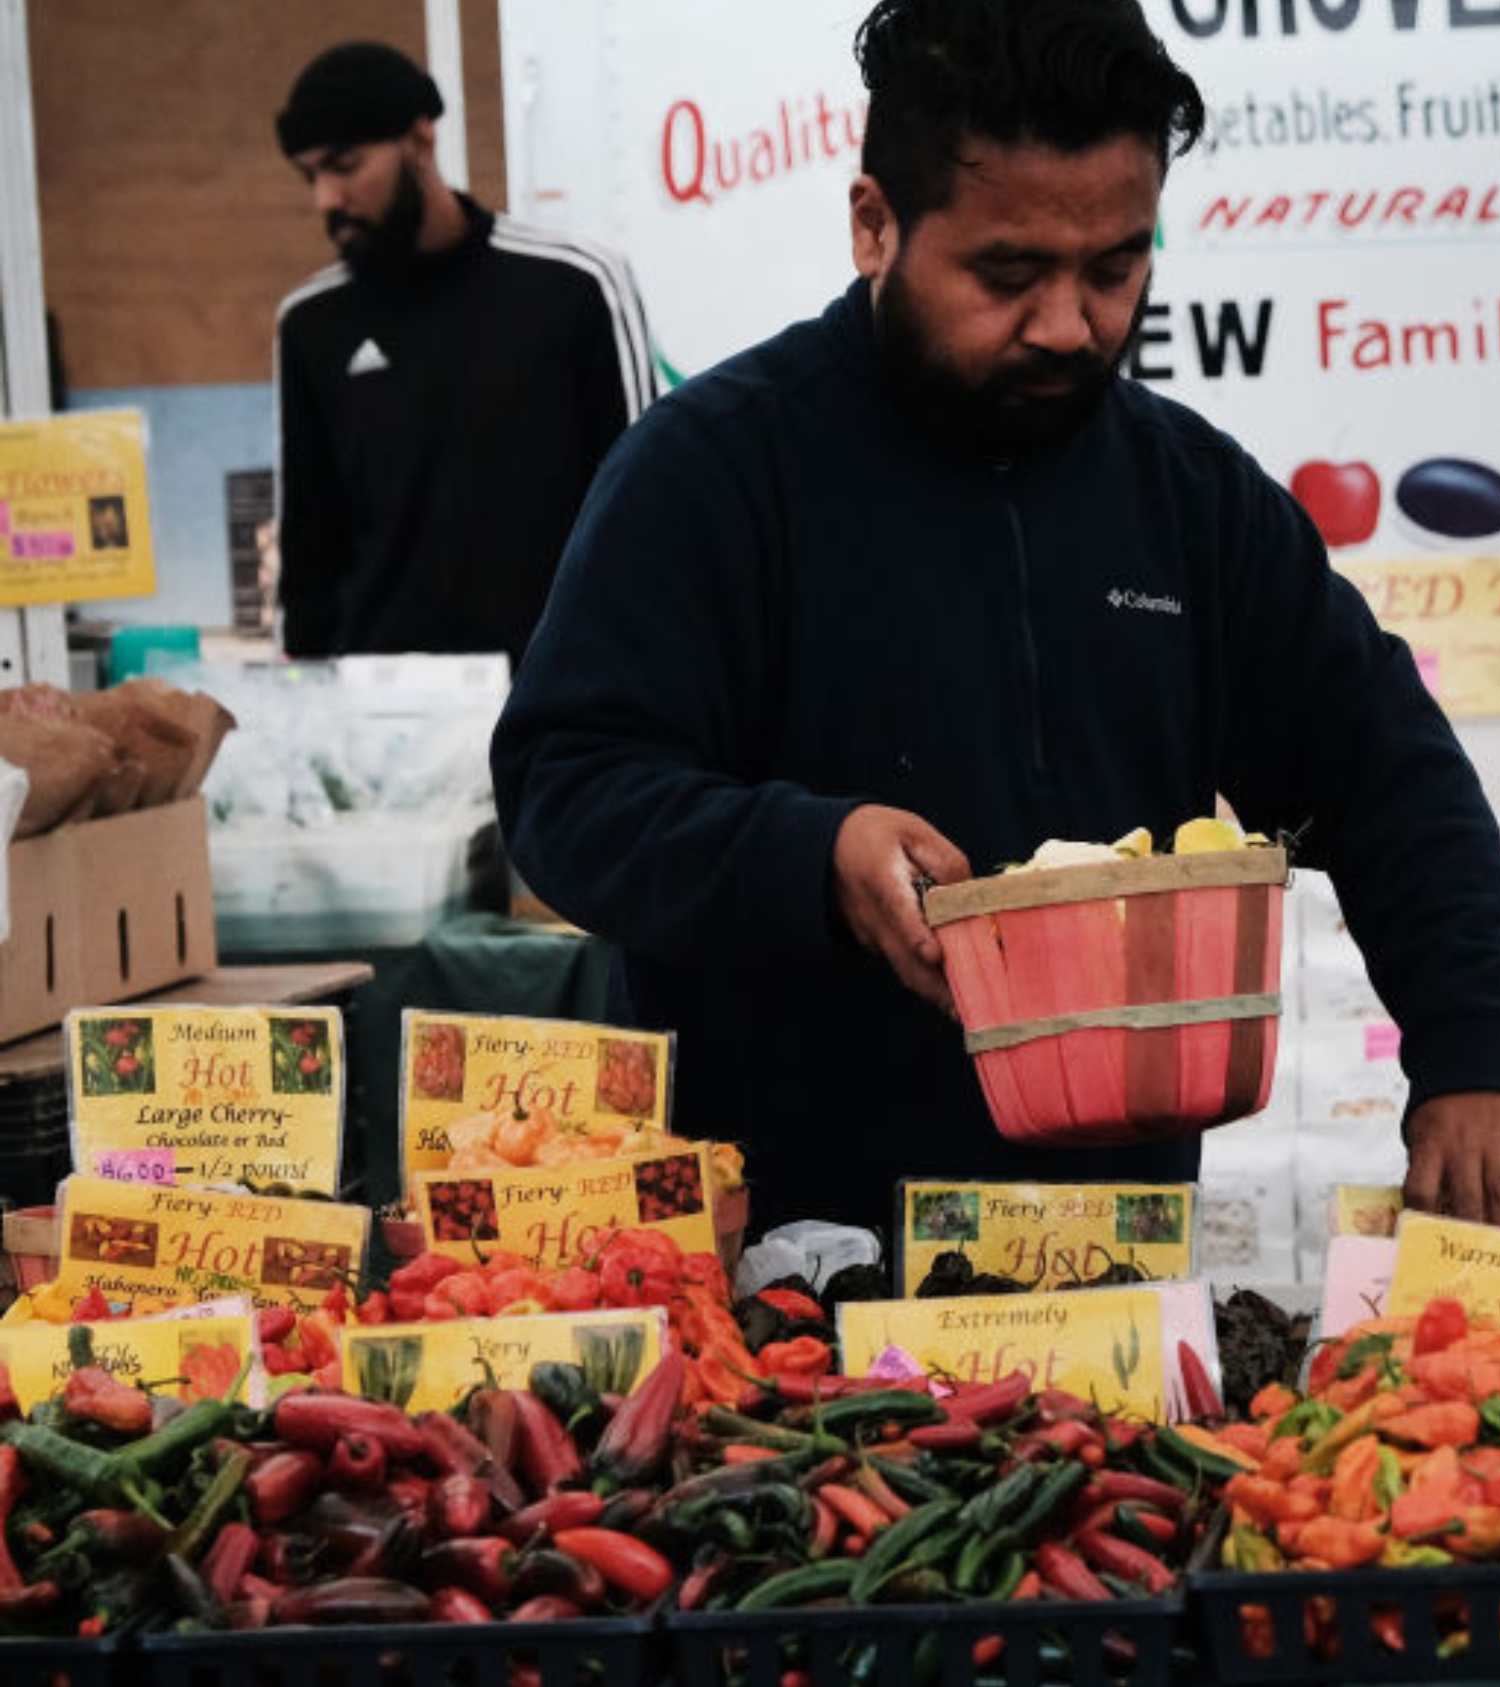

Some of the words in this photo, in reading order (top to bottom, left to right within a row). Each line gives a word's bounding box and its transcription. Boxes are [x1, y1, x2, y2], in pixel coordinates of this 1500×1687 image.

[1130, 299, 1273, 380] EW
[1124, 589, 1182, 616] Columbia
[168, 1018, 257, 1043] Medium
[540, 1035, 595, 1061] RED
[178, 1049, 255, 1090] Hot
[479, 1059, 582, 1120] Hot
[136, 1104, 203, 1130] Large
[144, 1130, 230, 1150] Chocolate
[577, 1172, 632, 1198] RED
[224, 1199, 284, 1222] RED
[160, 1230, 259, 1278] Hot
[921, 1305, 1069, 1332] Extremely
